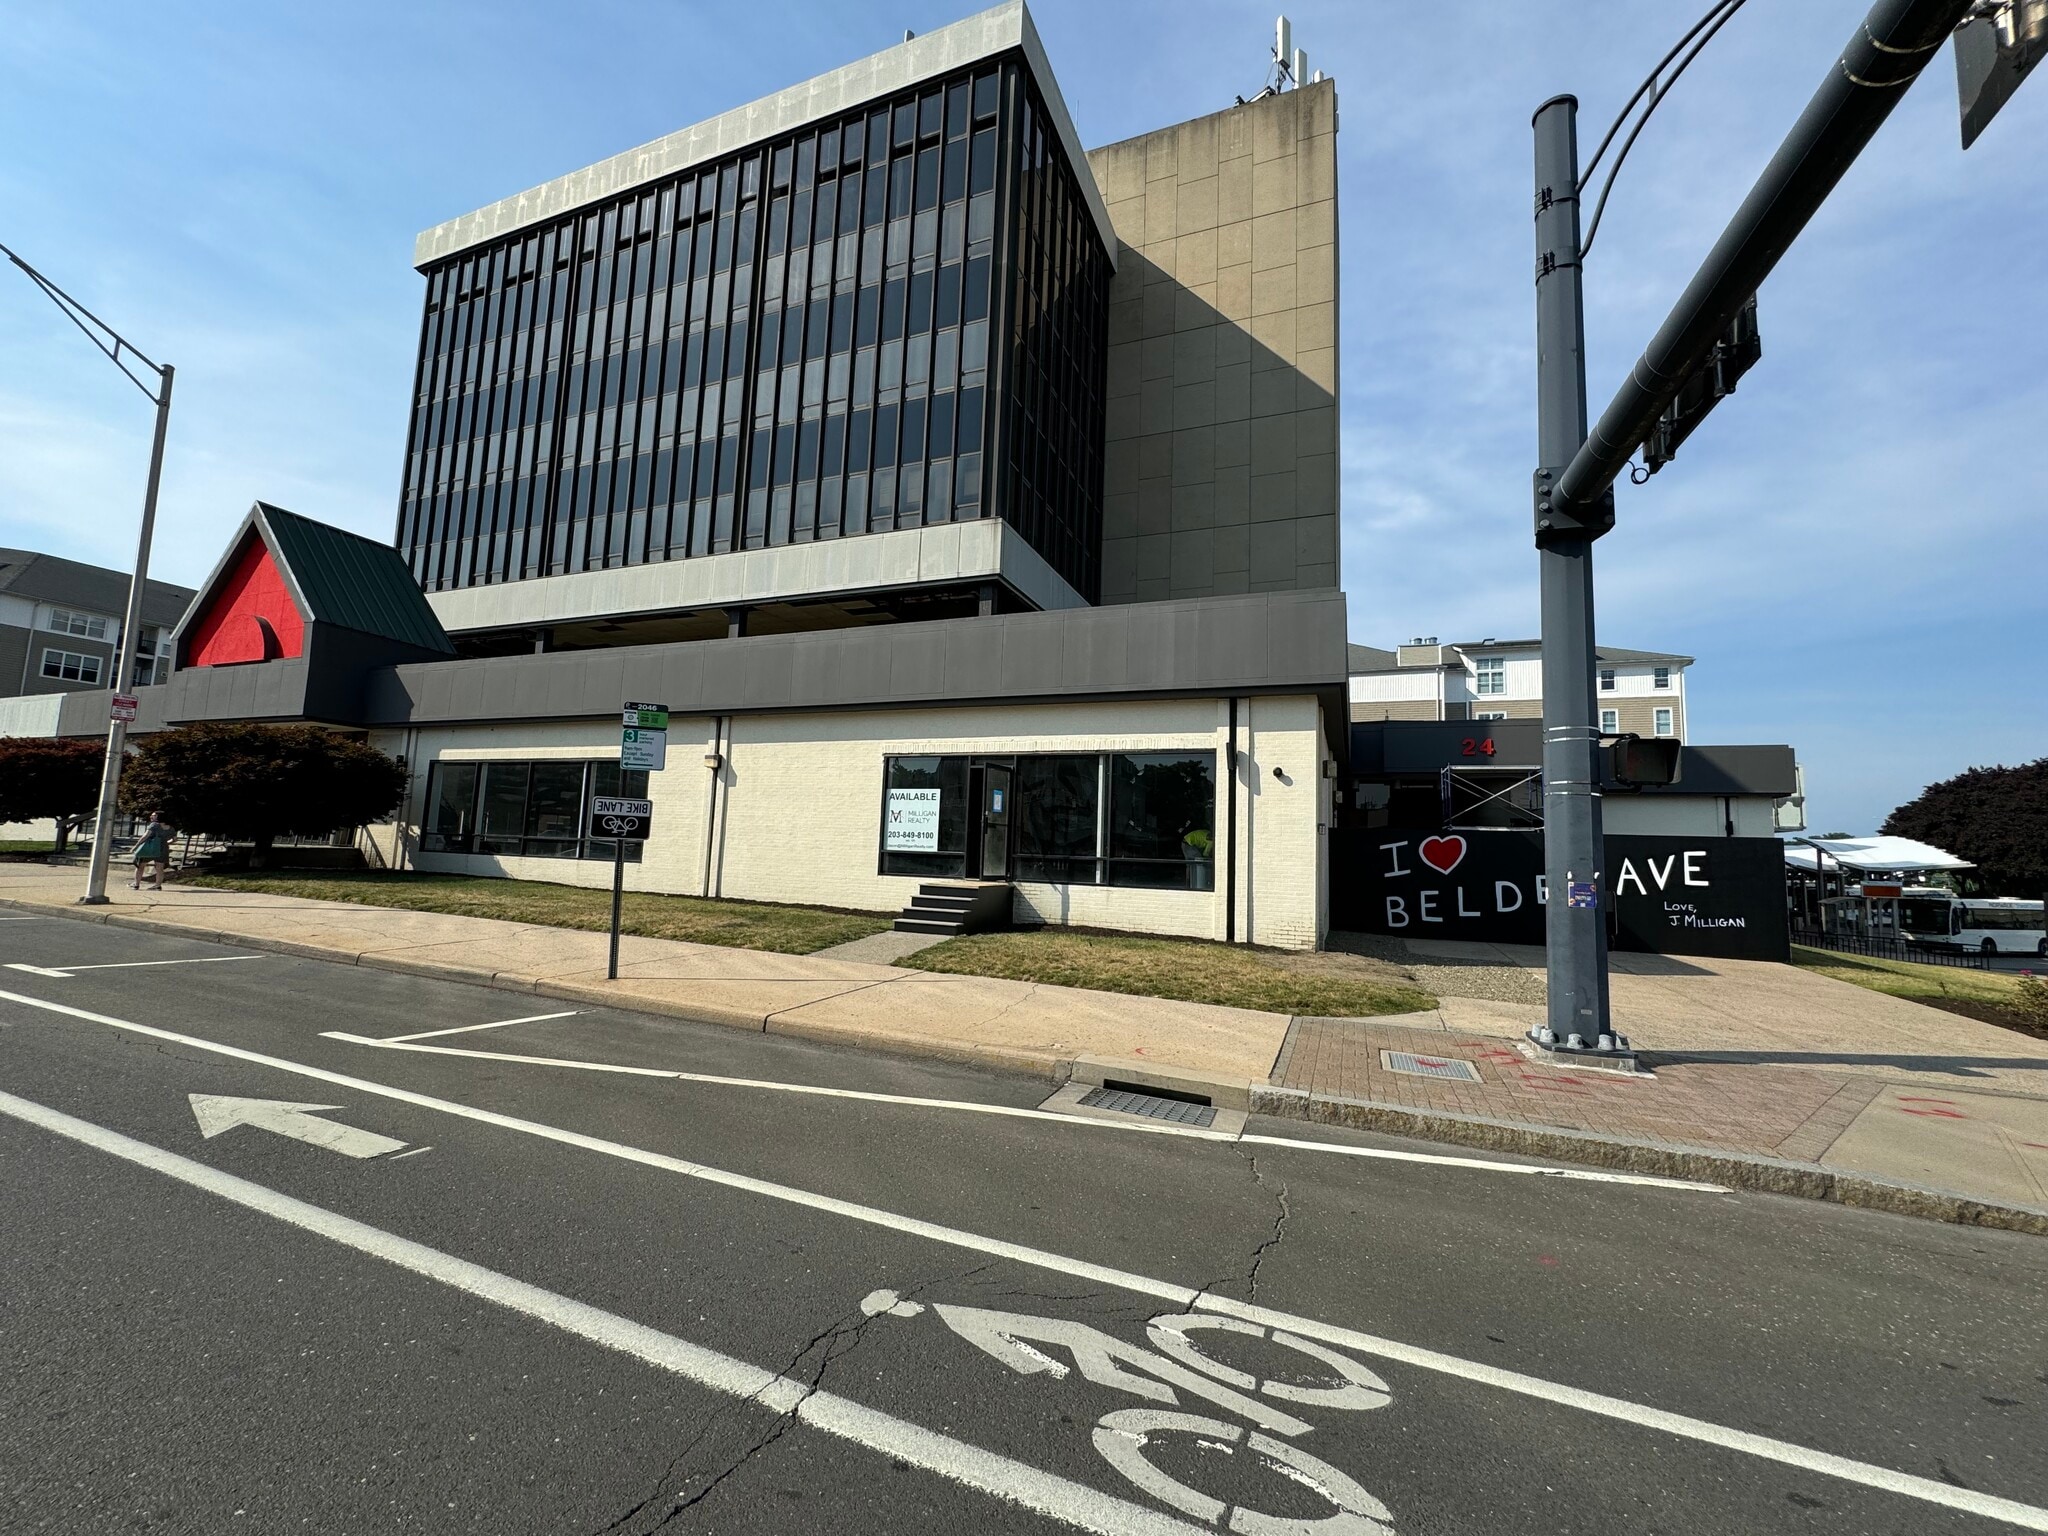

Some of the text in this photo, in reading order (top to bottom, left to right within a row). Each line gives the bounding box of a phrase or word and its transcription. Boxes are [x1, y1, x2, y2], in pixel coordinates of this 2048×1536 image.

[625, 730, 635, 742] 3
[1462, 738, 1494, 755] 24
[597, 800, 648, 814] BIKE LANE
[888, 831, 934, 839] 203-849-8100
[1379, 840, 1411, 877] I
[1386, 851, 1709, 928] BELDE AVE
[1684, 914, 1746, 928] MILLIGAN
